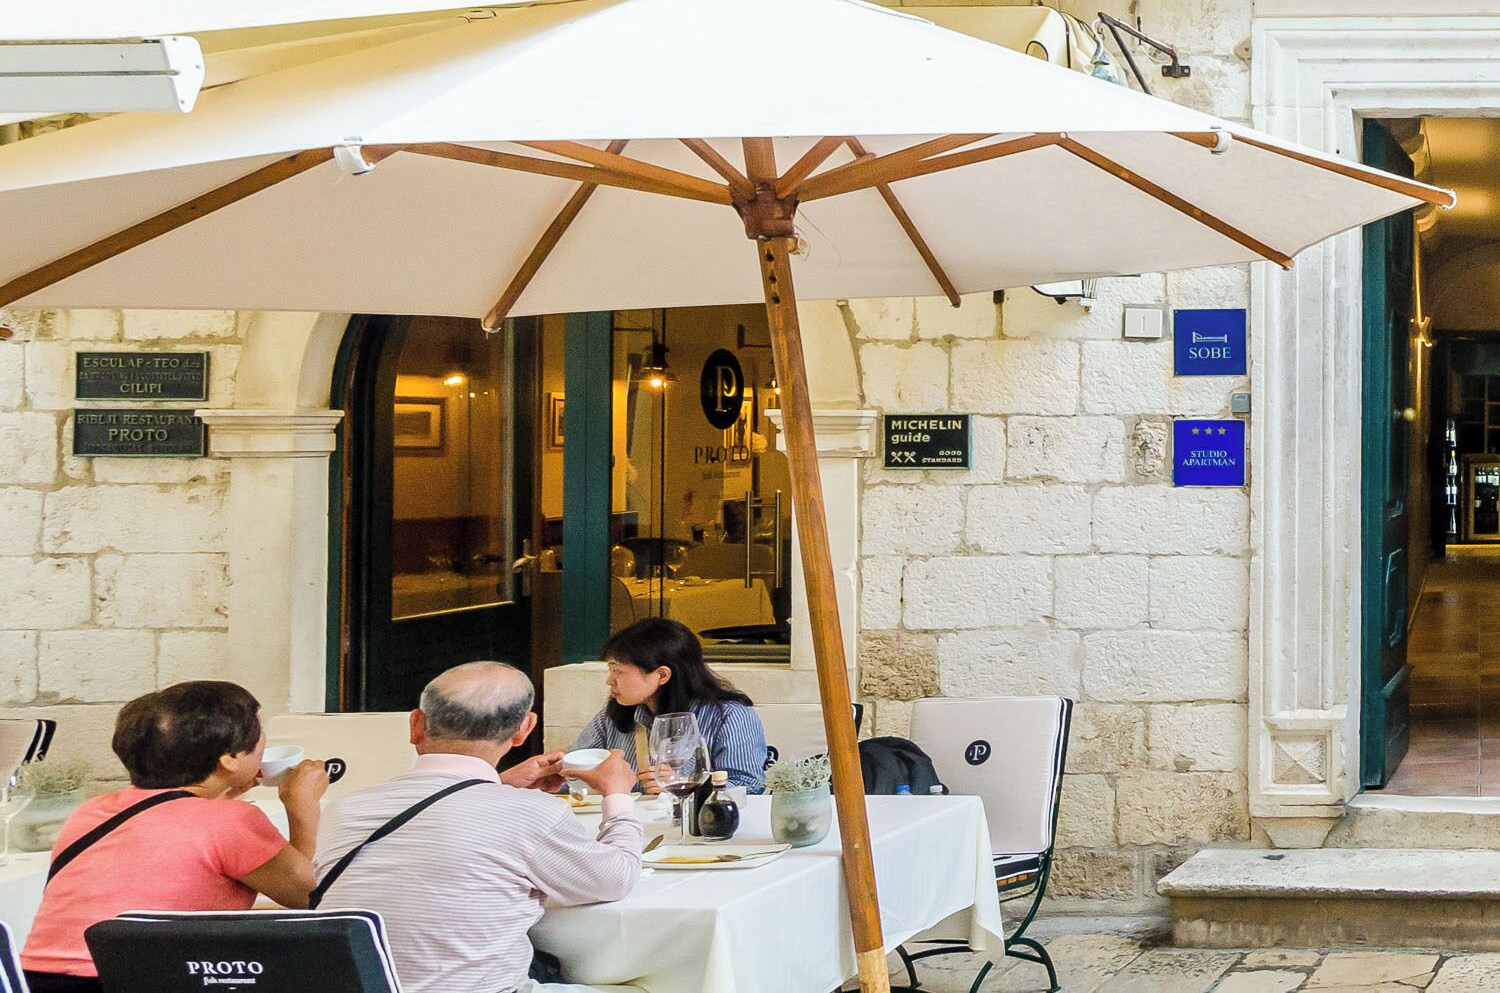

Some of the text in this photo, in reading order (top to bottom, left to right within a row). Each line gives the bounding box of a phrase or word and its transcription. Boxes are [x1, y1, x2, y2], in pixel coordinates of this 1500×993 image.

[1188, 347, 1232, 359] SOBE
[77, 415, 199, 426] RIBLJI RESTAURANT
[891, 420, 962, 430] MICHELIN
[107, 429, 168, 442] PROTO
[891, 432, 931, 444] guide
[694, 446, 750, 463] PROTO
[1190, 450, 1228, 458] STUDIO
[1182, 458, 1236, 466] APARTMAN
[186, 961, 264, 975] PROTO
